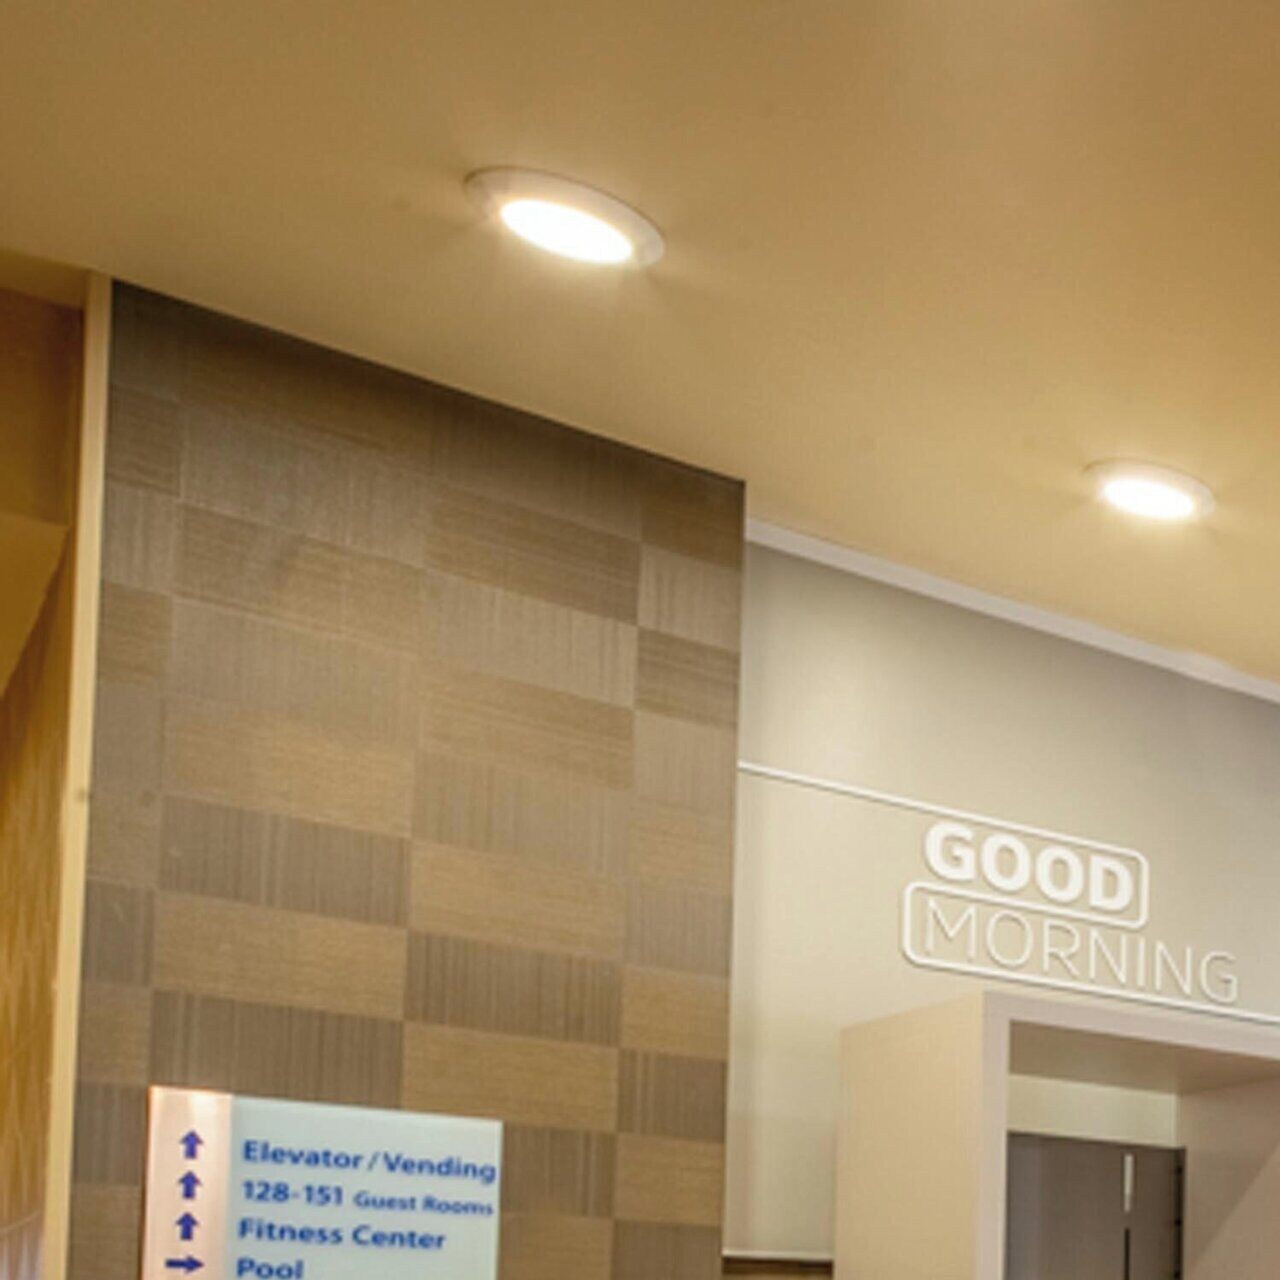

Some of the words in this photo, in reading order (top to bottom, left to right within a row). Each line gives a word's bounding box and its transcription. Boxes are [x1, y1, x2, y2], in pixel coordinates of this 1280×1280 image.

[924, 821, 1134, 912] GOOD
[924, 896, 1239, 1004] MORNING
[241, 1179, 344, 1207] 128-151
[353, 1189, 417, 1212] Guest
[422, 1196, 494, 1218] Rooms
[237, 1217, 344, 1245] Fitness
[351, 1223, 447, 1251] Center
[236, 1255, 304, 1280] Pool
